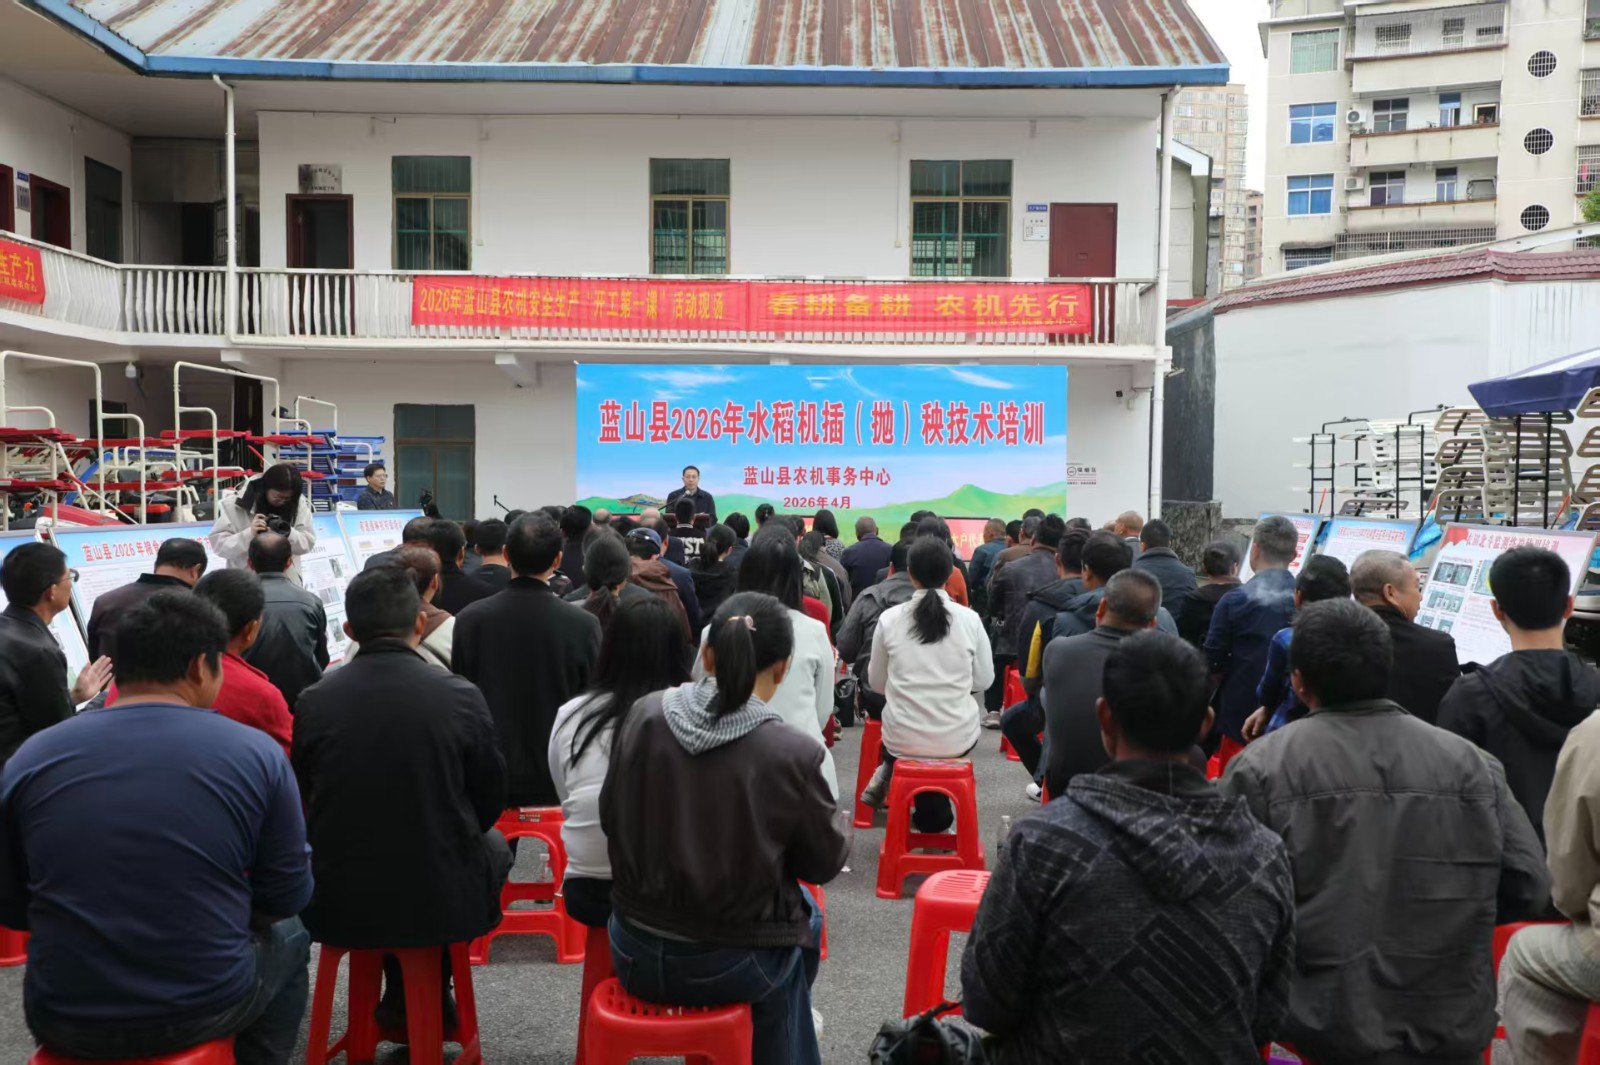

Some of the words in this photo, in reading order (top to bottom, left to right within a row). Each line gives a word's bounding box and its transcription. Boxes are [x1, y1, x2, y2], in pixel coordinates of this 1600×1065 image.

[768, 293, 913, 316] 春耕备耕
[934, 293, 1079, 317] 农机先行
[599, 400, 1044, 445] 蓝山县2026年水稻机插（抛）秧技术培训
[743, 466, 891, 486] 蓝山县农机事务中心
[783, 496, 851, 509] 2026年4月
